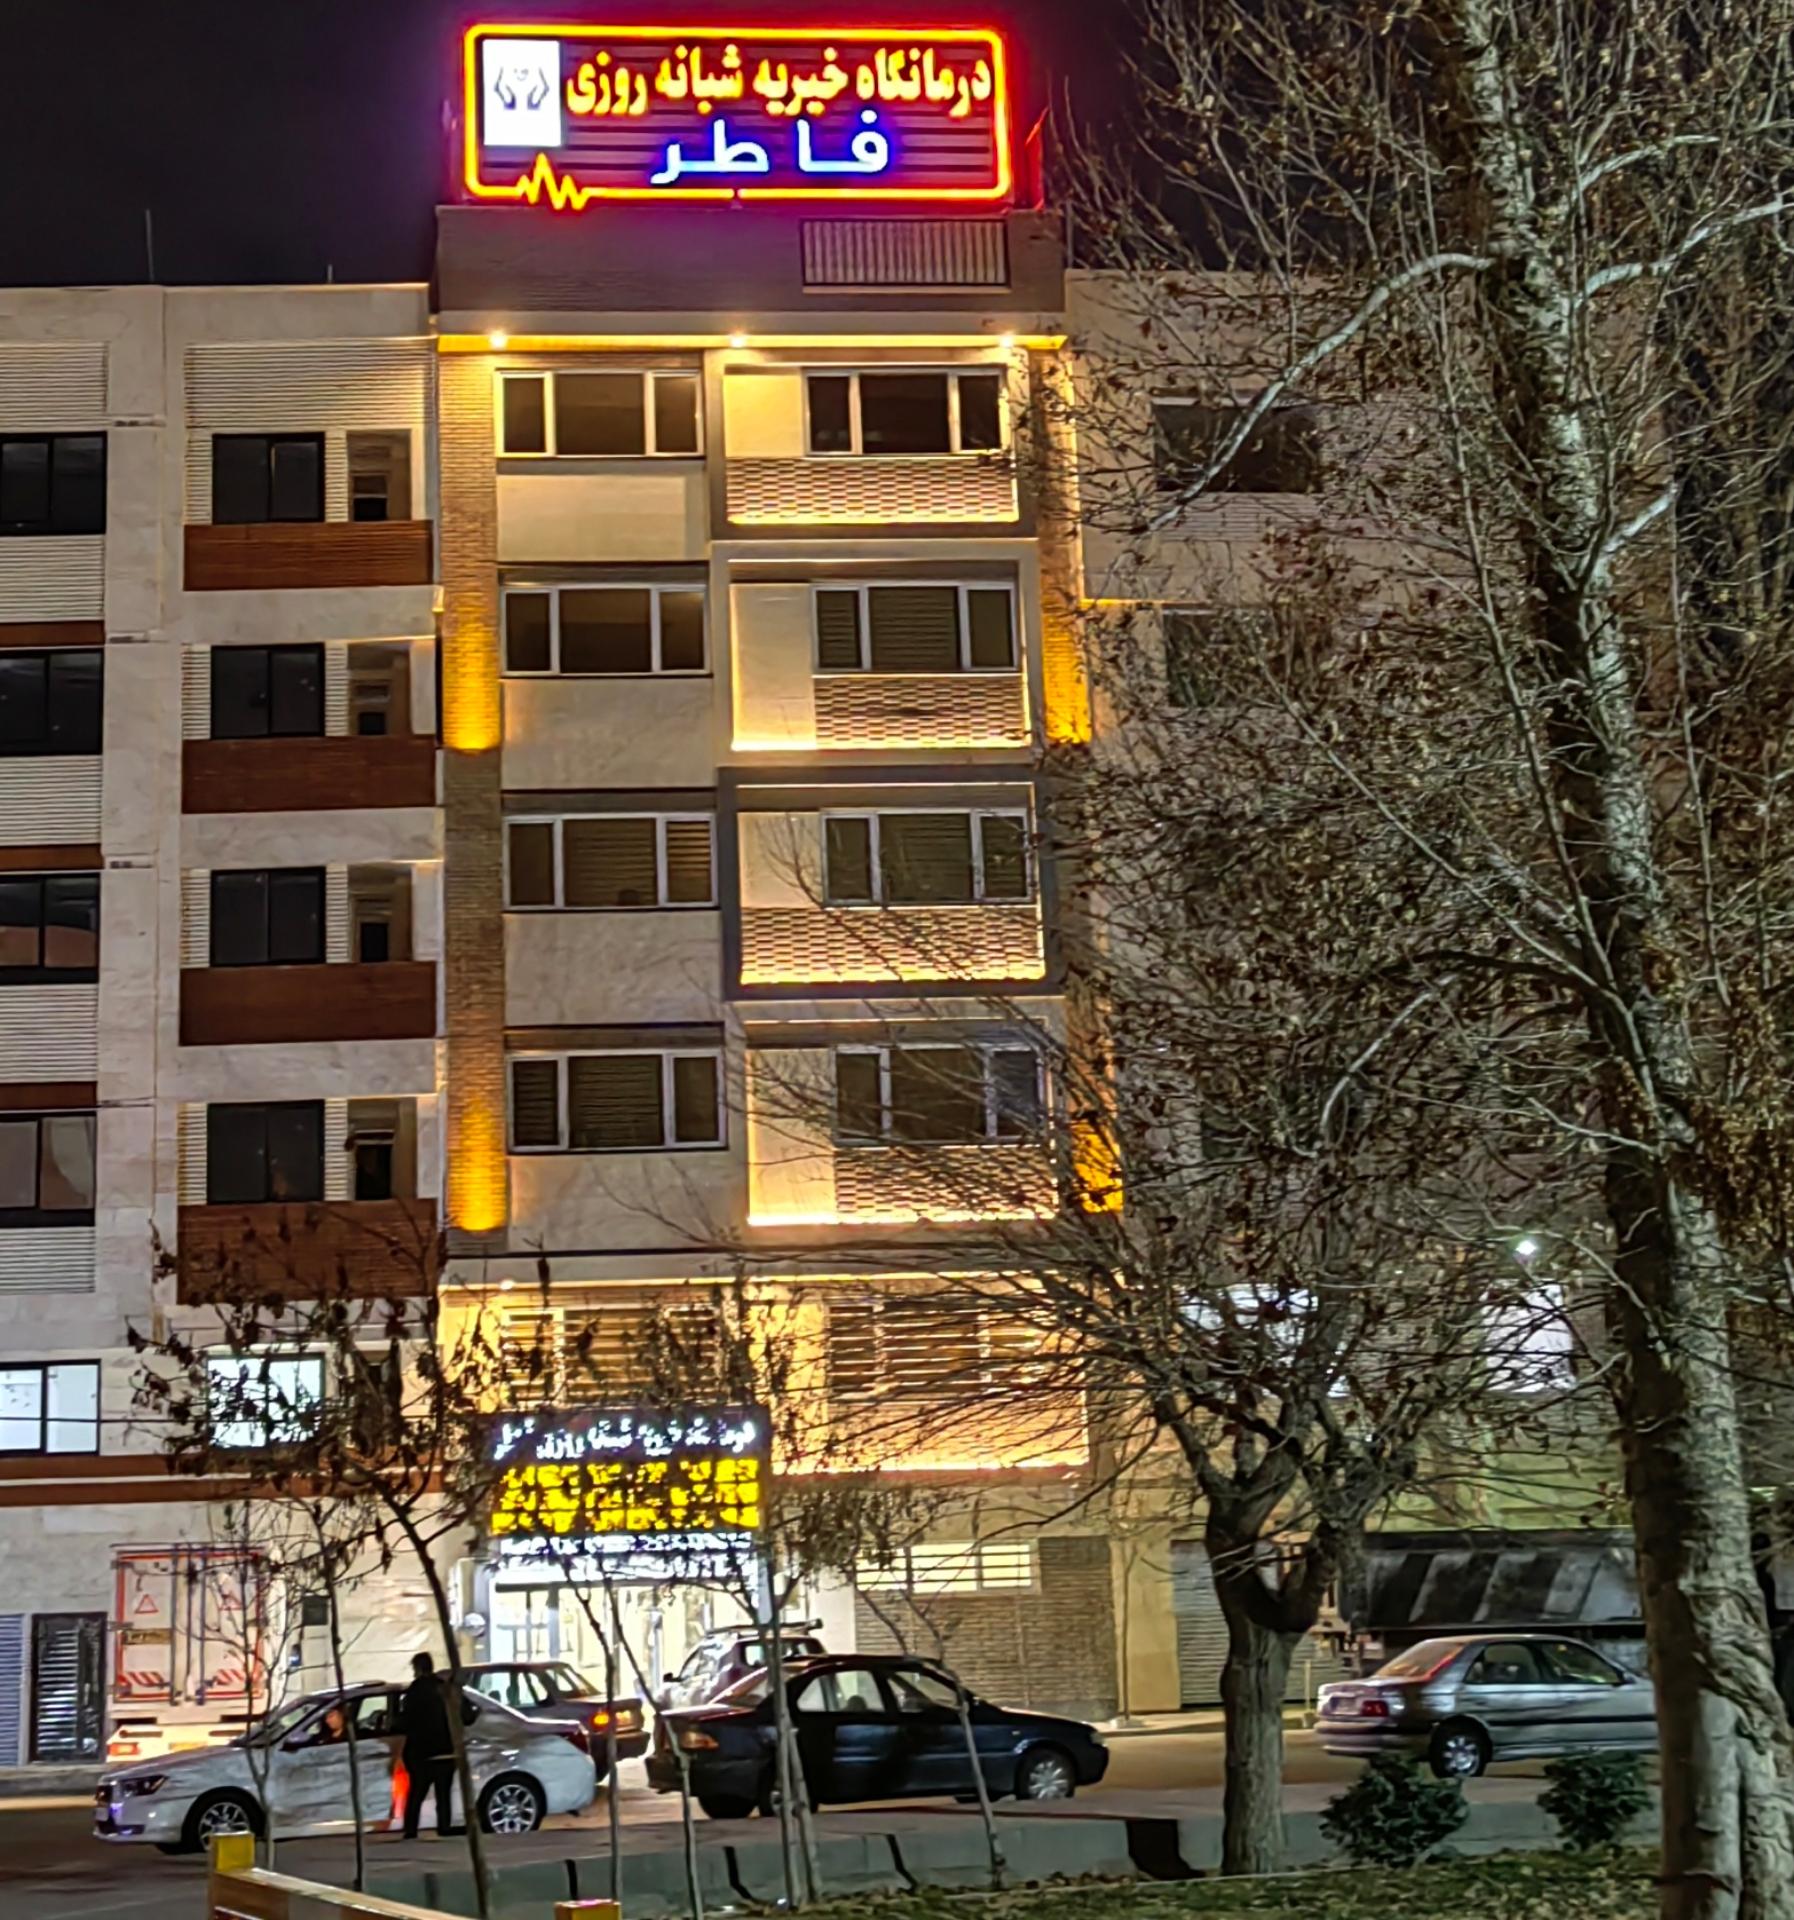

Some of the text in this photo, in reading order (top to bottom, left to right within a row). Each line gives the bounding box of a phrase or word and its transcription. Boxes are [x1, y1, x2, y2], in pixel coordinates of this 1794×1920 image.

[566, 43, 992, 117] درمانگاه خیریه شبانه روزی
